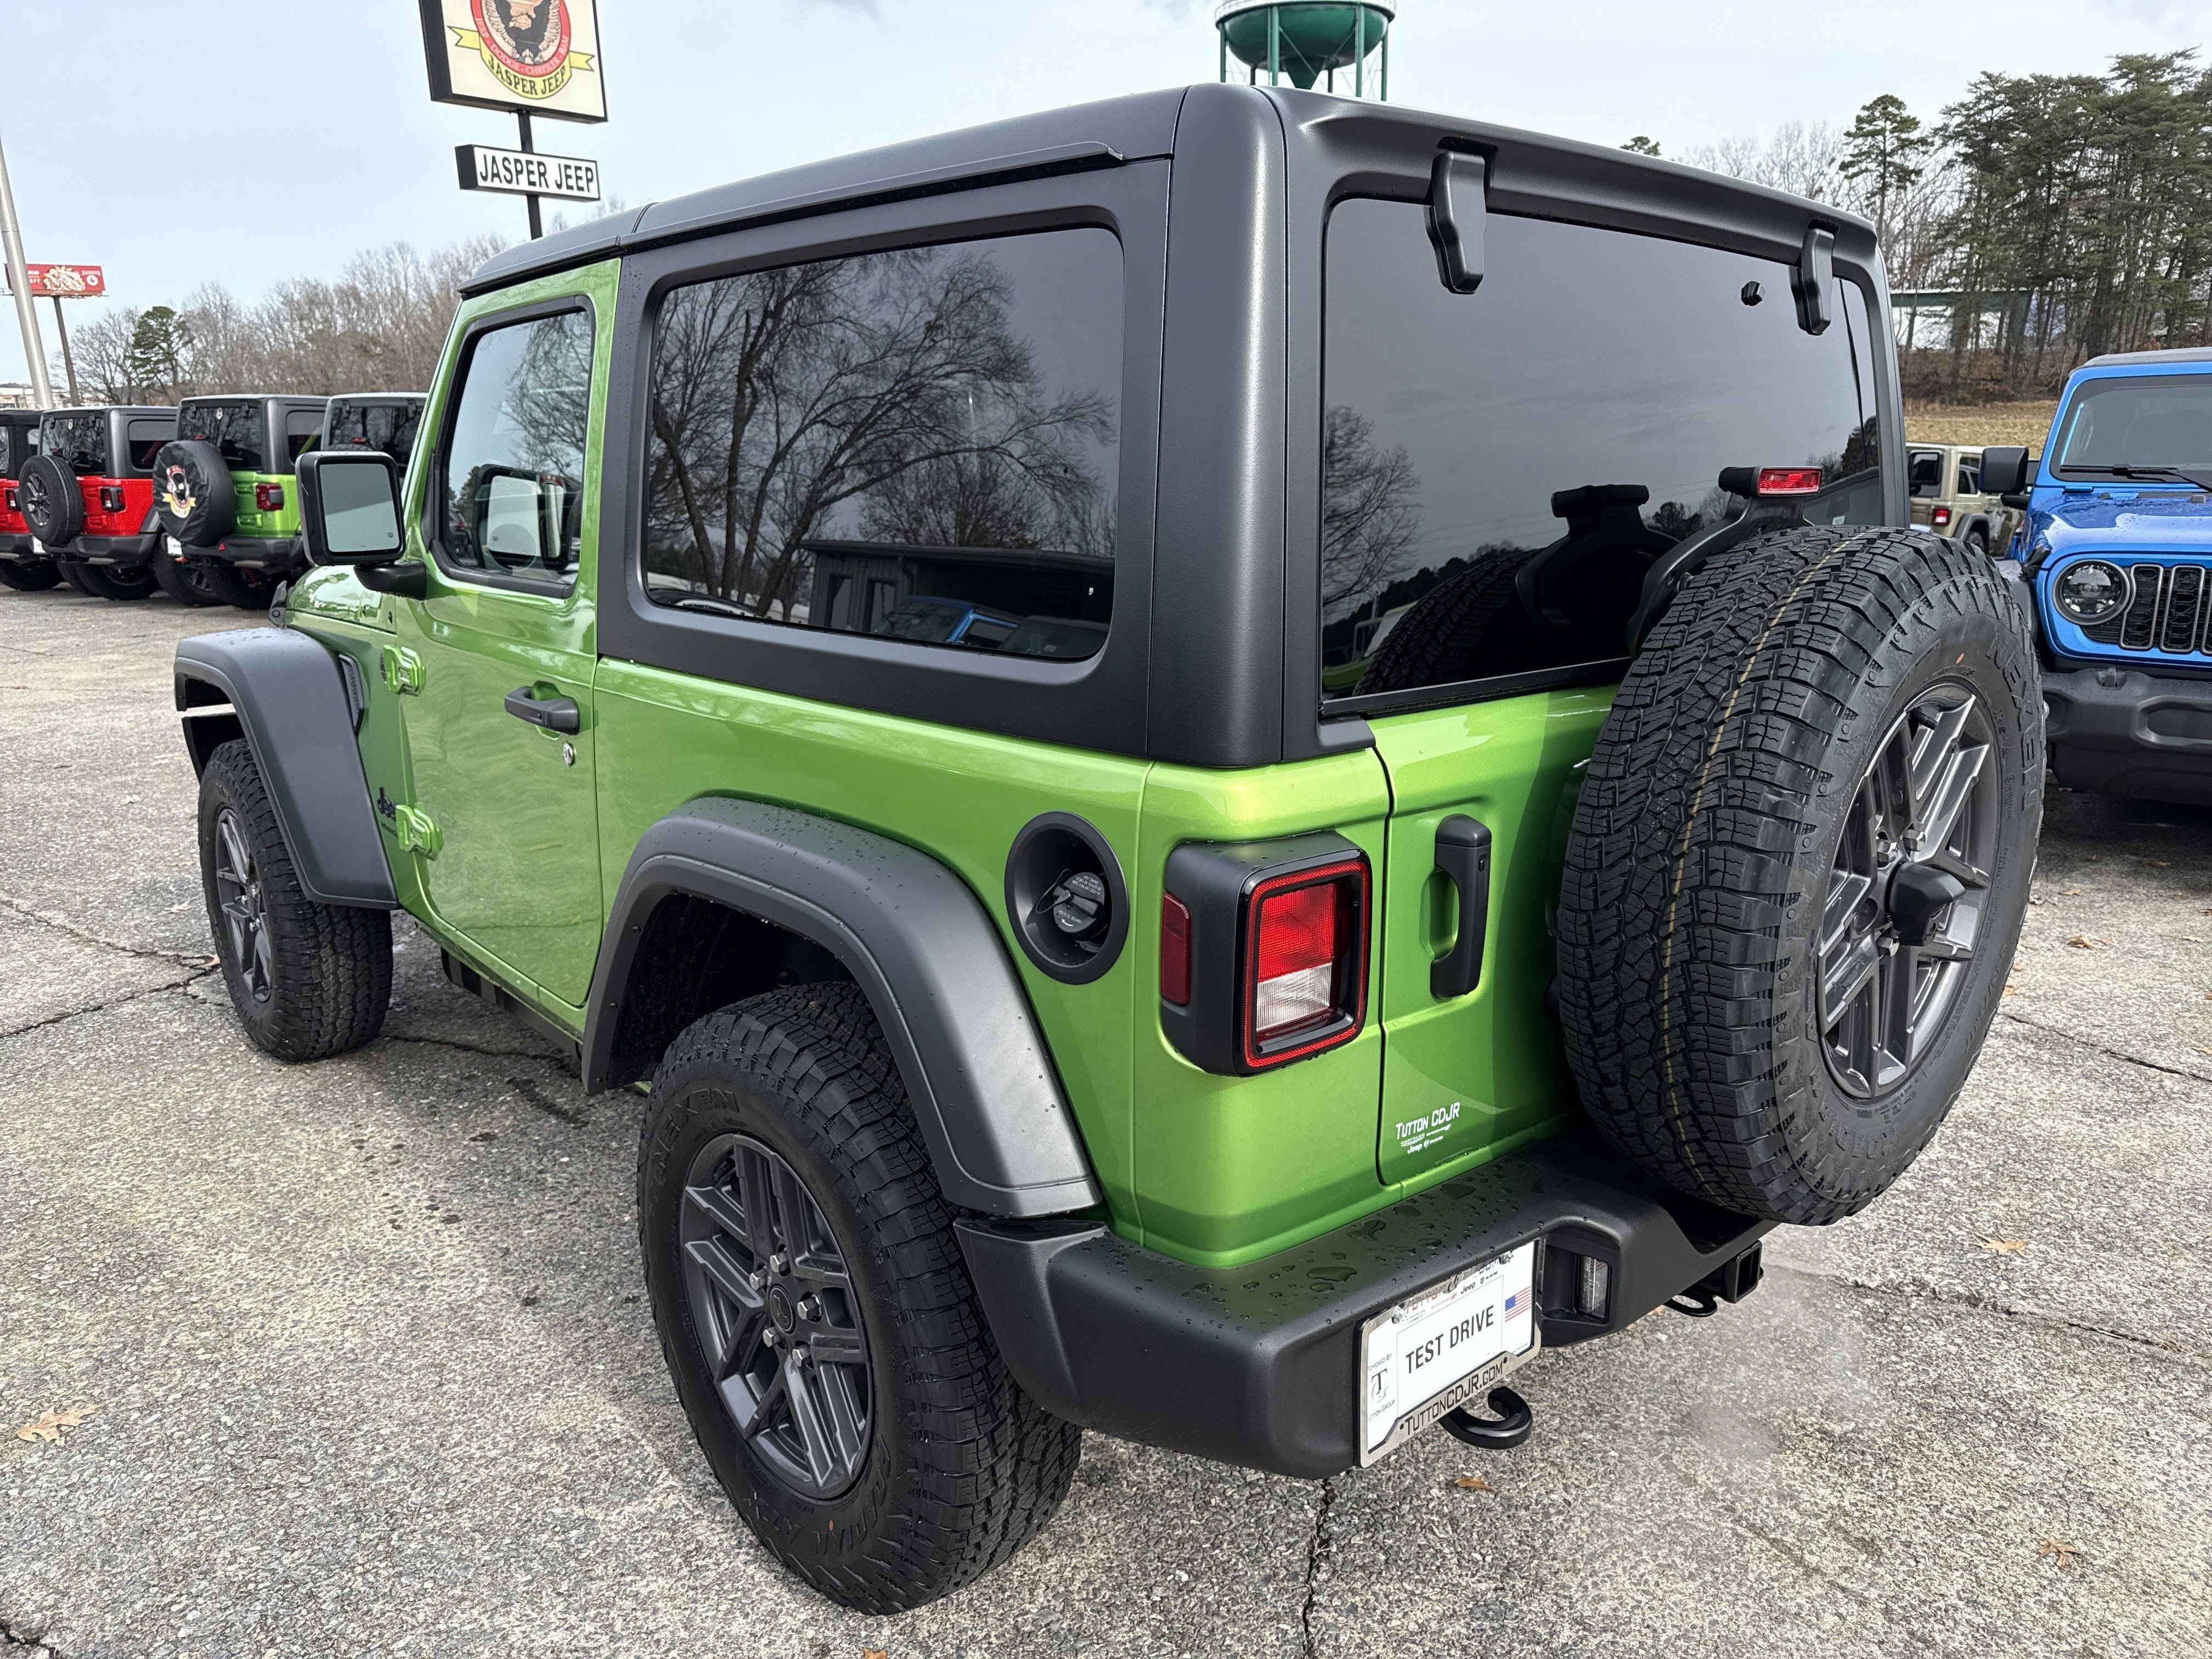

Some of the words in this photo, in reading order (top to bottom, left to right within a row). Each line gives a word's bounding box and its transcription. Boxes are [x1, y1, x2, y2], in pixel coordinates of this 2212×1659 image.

[488, 54, 538, 96] JASPER
[541, 65, 566, 94] JEEP
[479, 154, 549, 189] JASPER
[555, 163, 594, 193] JEEP
[1985, 631, 2038, 812] NEXEN
[1396, 1115, 1429, 1140] TUTTON
[1431, 1101, 1460, 1127] CDJR
[1460, 1282, 1476, 1295] Jeep
[1386, 1353, 1392, 1361] BY
[1406, 1333, 1444, 1374] TEST
[1450, 1305, 1494, 1349] DRIVE
[1404, 1362, 1503, 1436] TUTTONCDJR.COM
